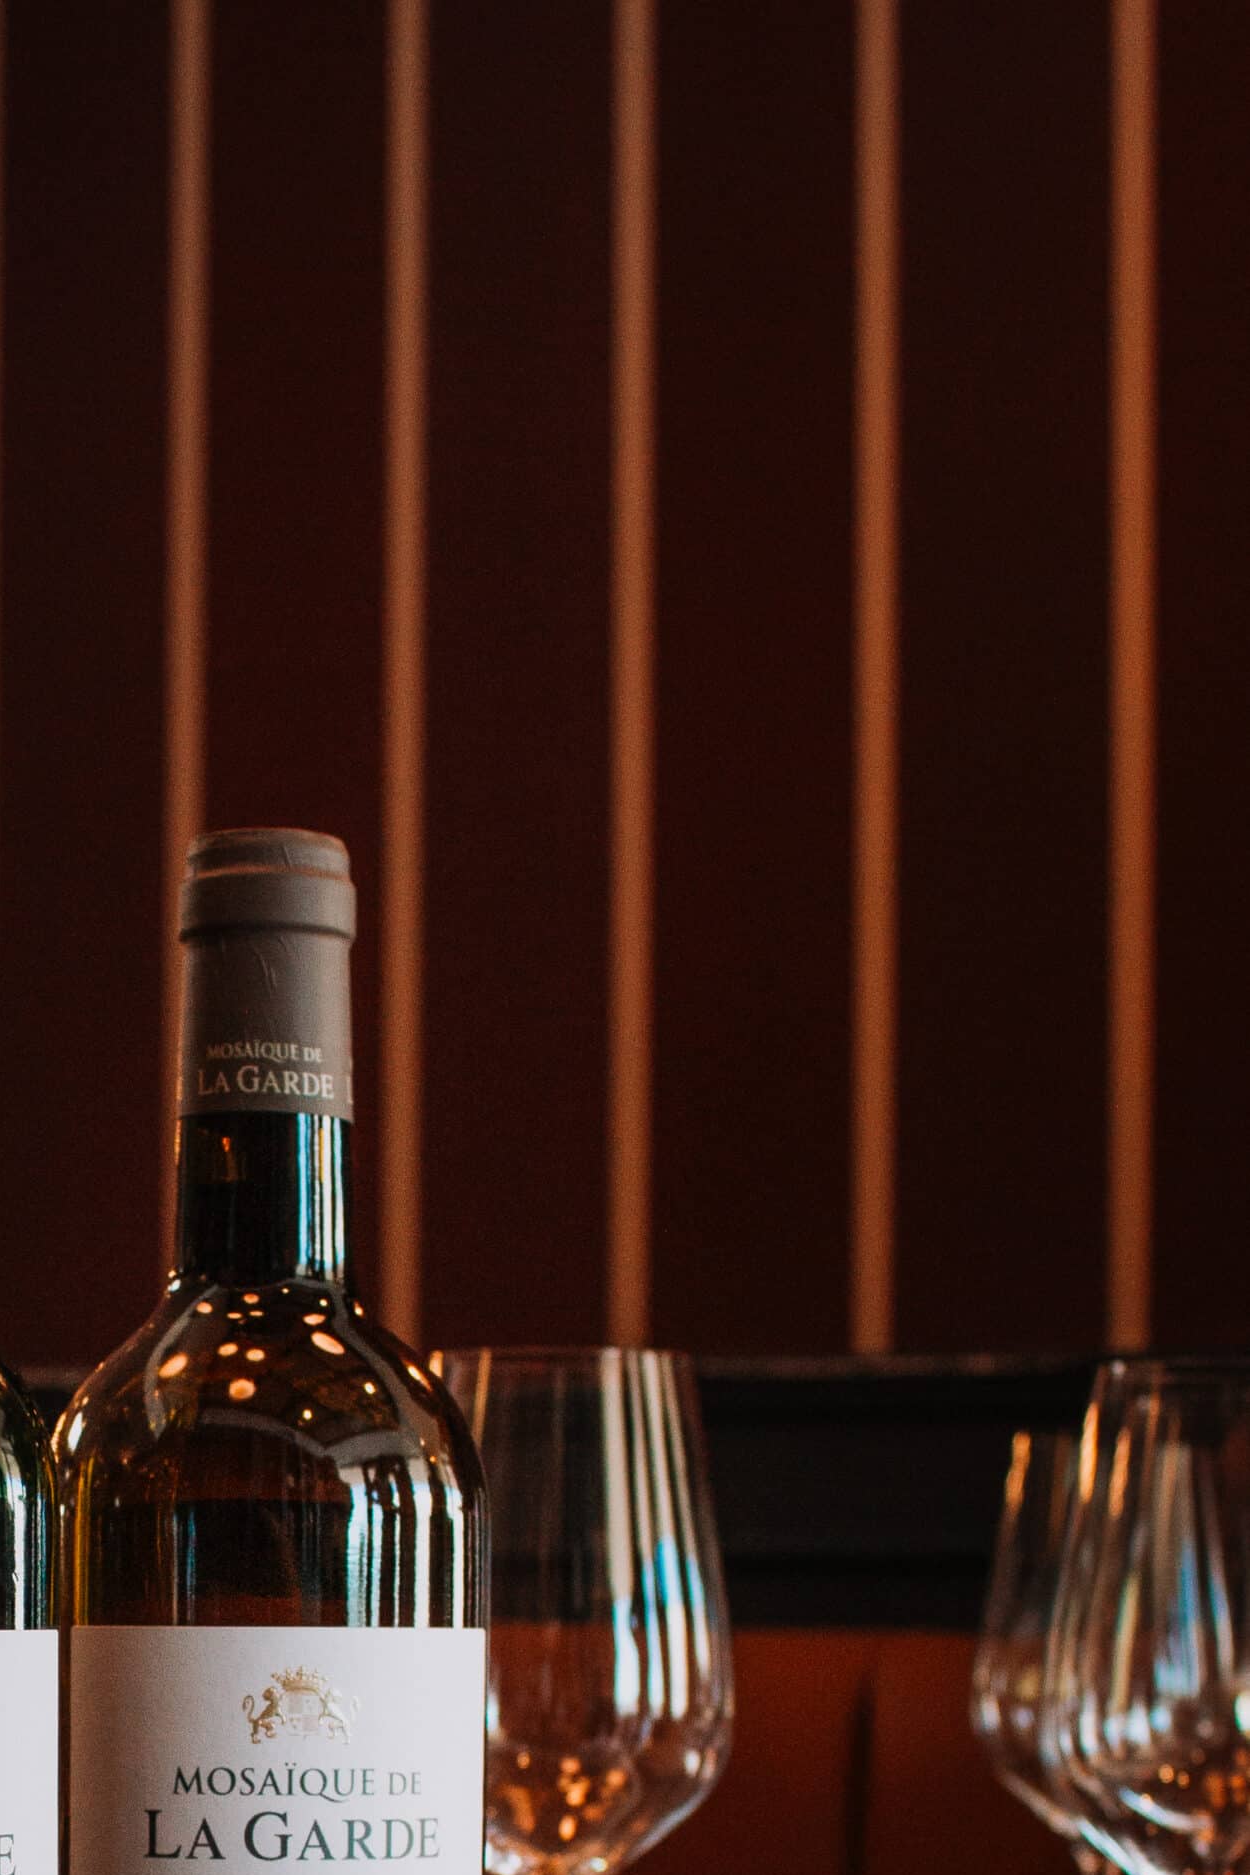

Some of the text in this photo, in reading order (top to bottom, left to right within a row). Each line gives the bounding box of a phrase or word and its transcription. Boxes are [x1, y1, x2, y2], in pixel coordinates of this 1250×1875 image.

[206, 1040, 323, 1063] MOSAÏQUE DE
[198, 1069, 231, 1095] LA
[236, 1064, 334, 1099] GARDE
[172, 1762, 422, 1803] MOSAÏQUE DE
[143, 1809, 441, 1861] LA GARDE
